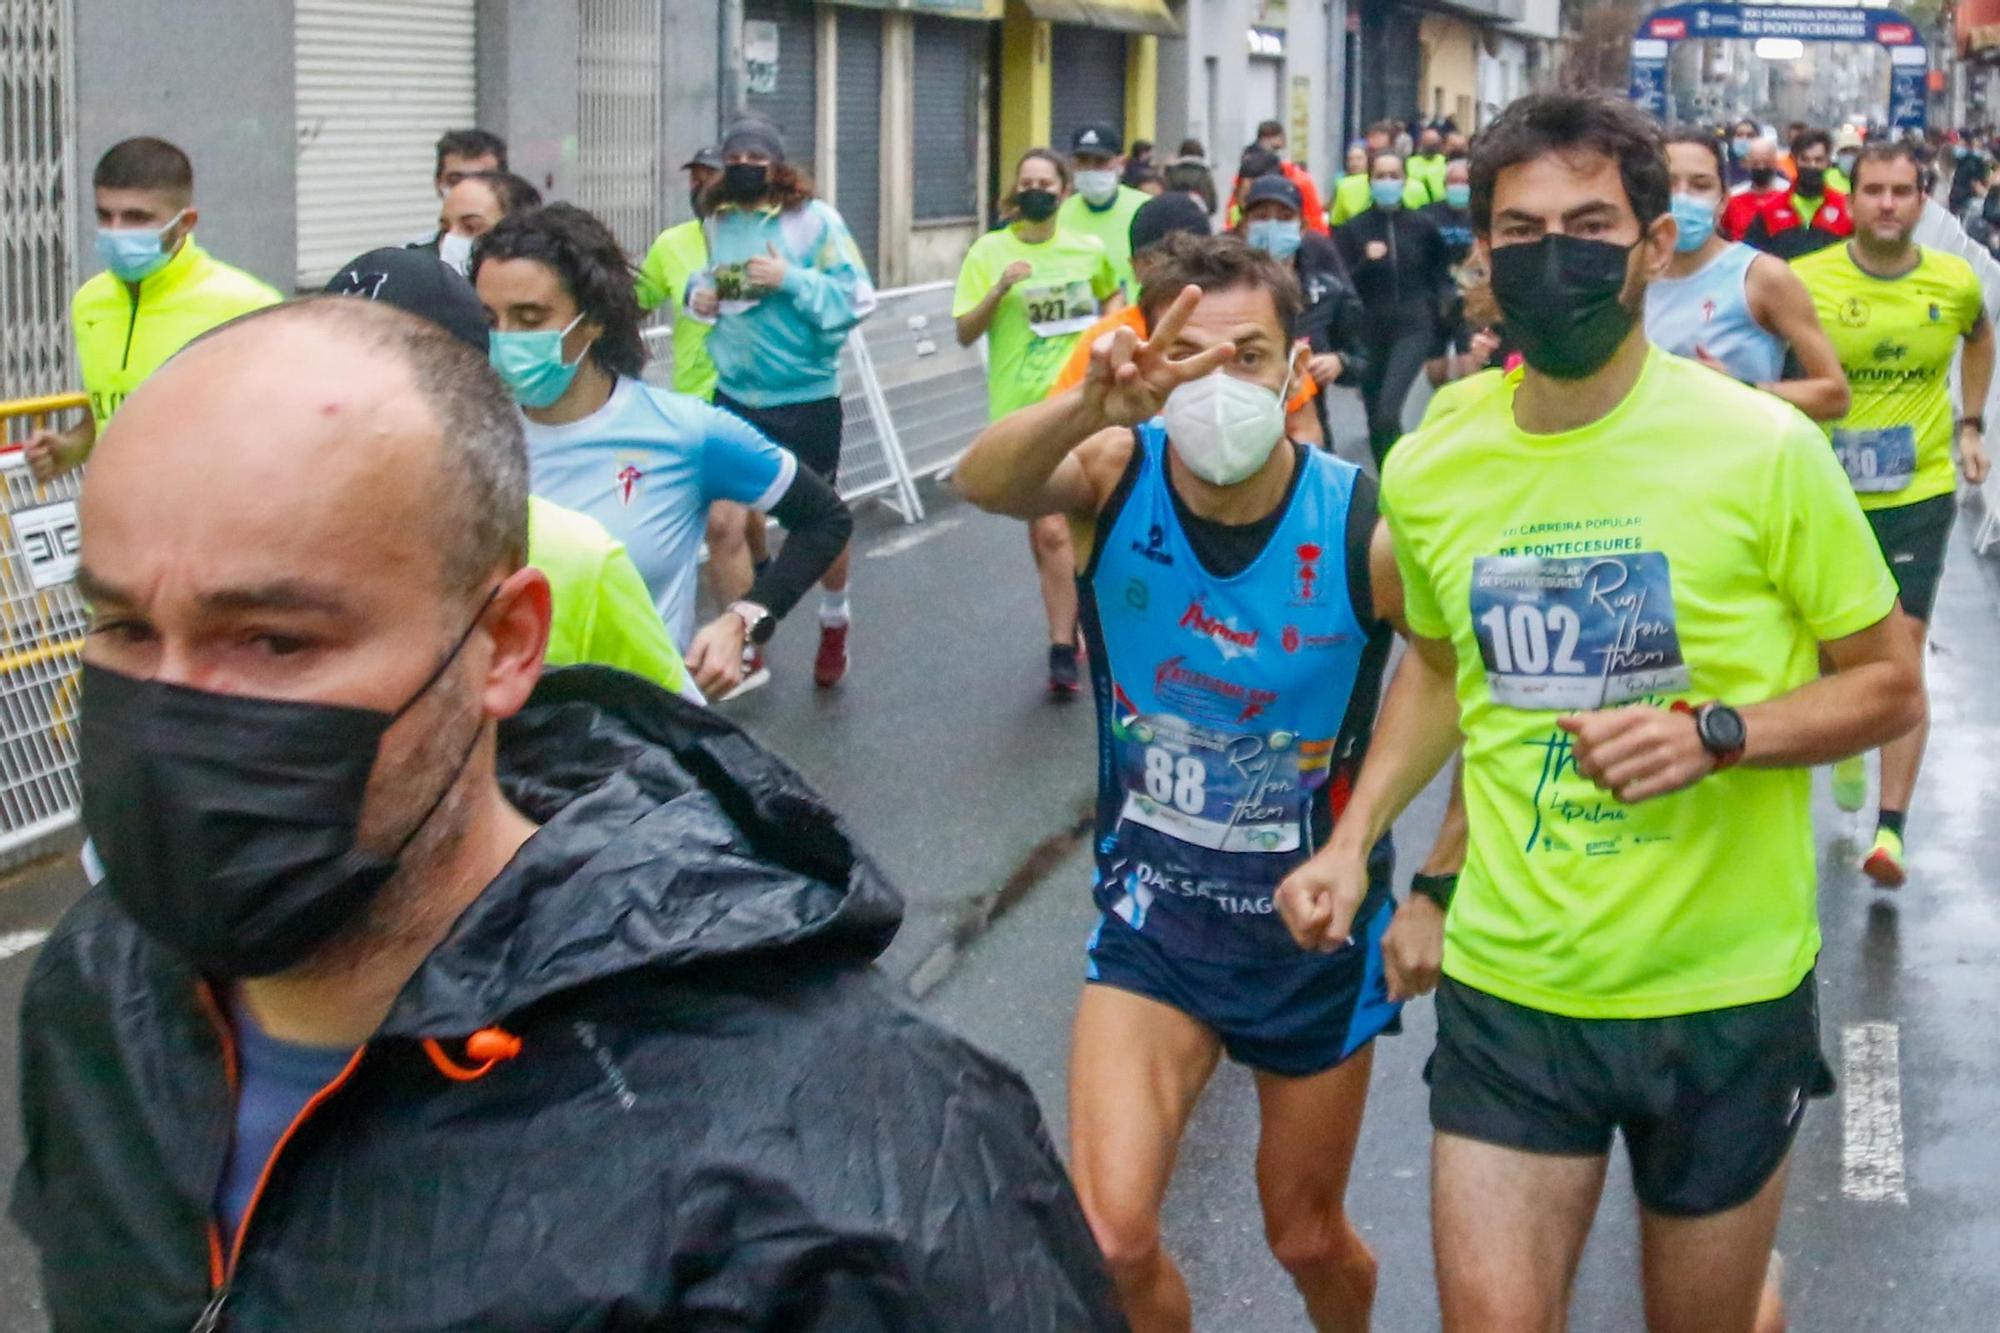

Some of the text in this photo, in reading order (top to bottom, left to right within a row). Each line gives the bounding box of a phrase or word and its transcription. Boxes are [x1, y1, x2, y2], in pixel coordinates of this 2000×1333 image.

[1762, 8, 1818, 20] CARREIRA
[1818, 10, 1866, 22] POPULAR
[1743, 20, 1760, 33] DE
[1762, 21, 1866, 37] PONTECESURES
[1028, 299, 1064, 324] 327
[1520, 520, 1582, 535] CARREIRA
[1586, 516, 1642, 530] POPULAR
[1524, 537, 1643, 558] PONTECESURES
[1584, 558, 1638, 619] Run
[1480, 604, 1586, 675] 102
[1145, 747, 1206, 815] 88
[1563, 802, 1625, 824] Palma
